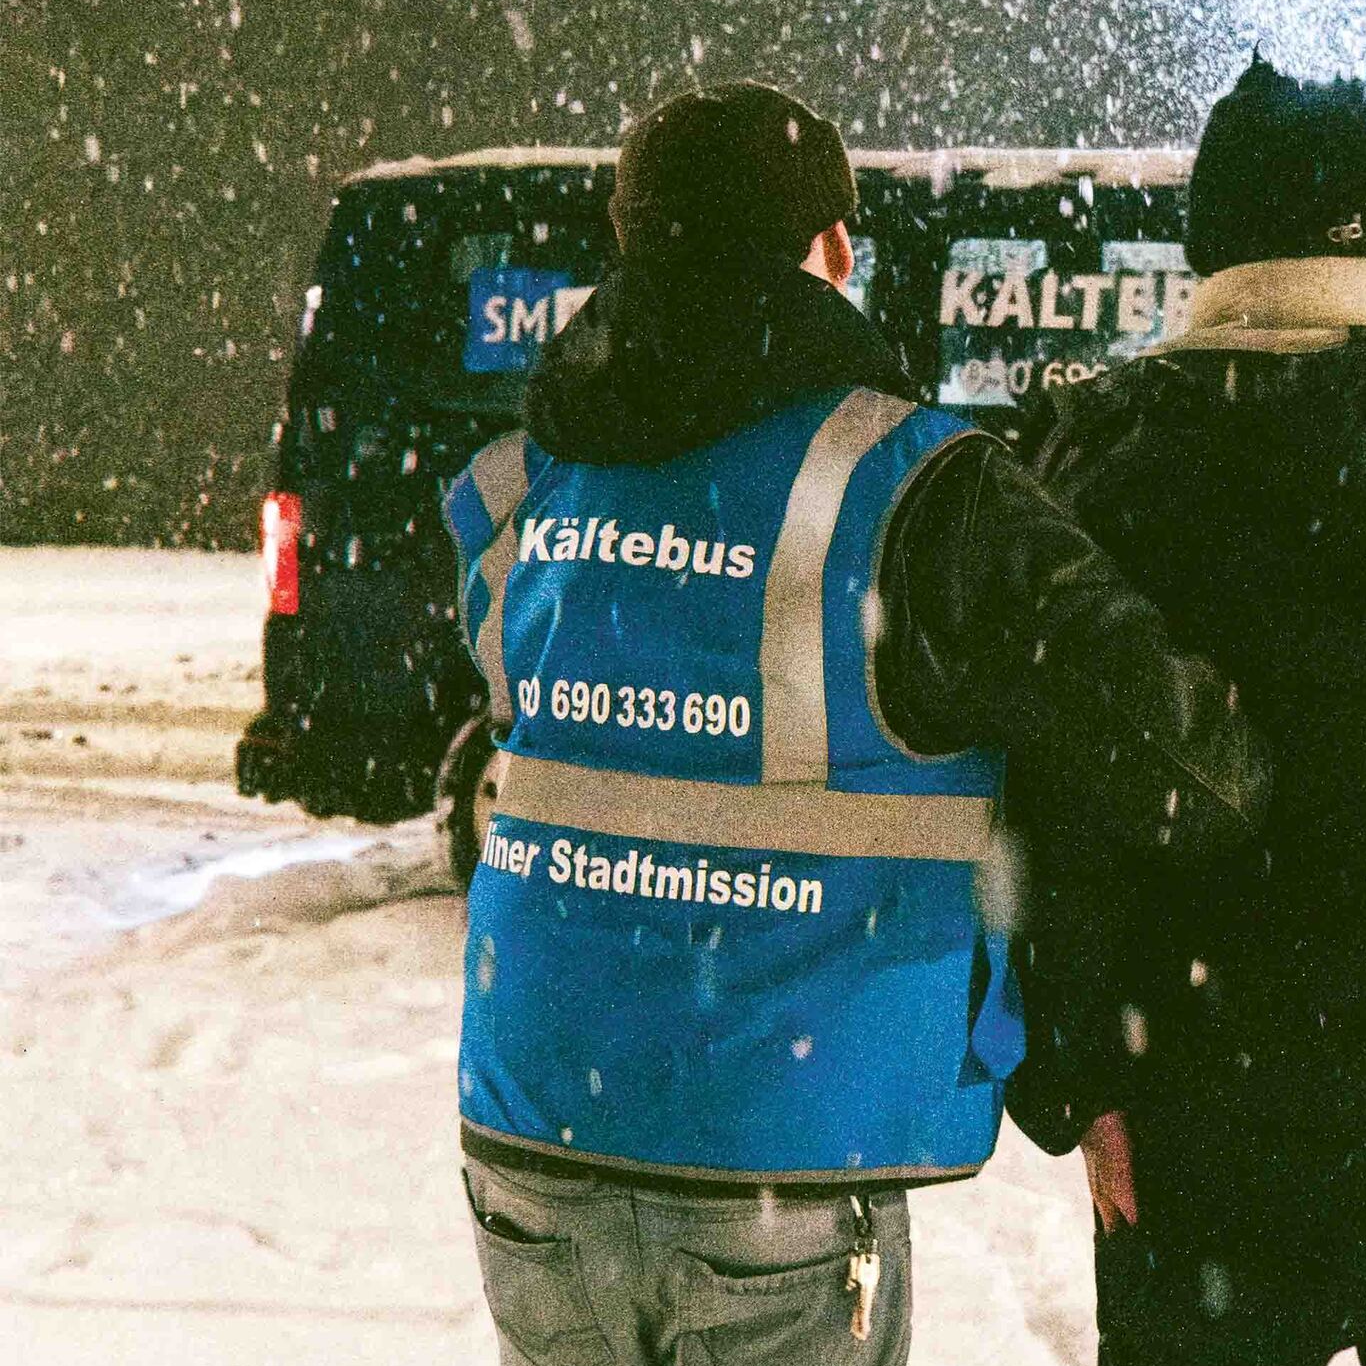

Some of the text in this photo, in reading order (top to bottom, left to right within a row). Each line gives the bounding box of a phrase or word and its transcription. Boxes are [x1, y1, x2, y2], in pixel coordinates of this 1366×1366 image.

[483, 295, 550, 344] SM
[519, 517, 756, 579] Kältebus
[549, 838, 823, 914] Stadtmission
